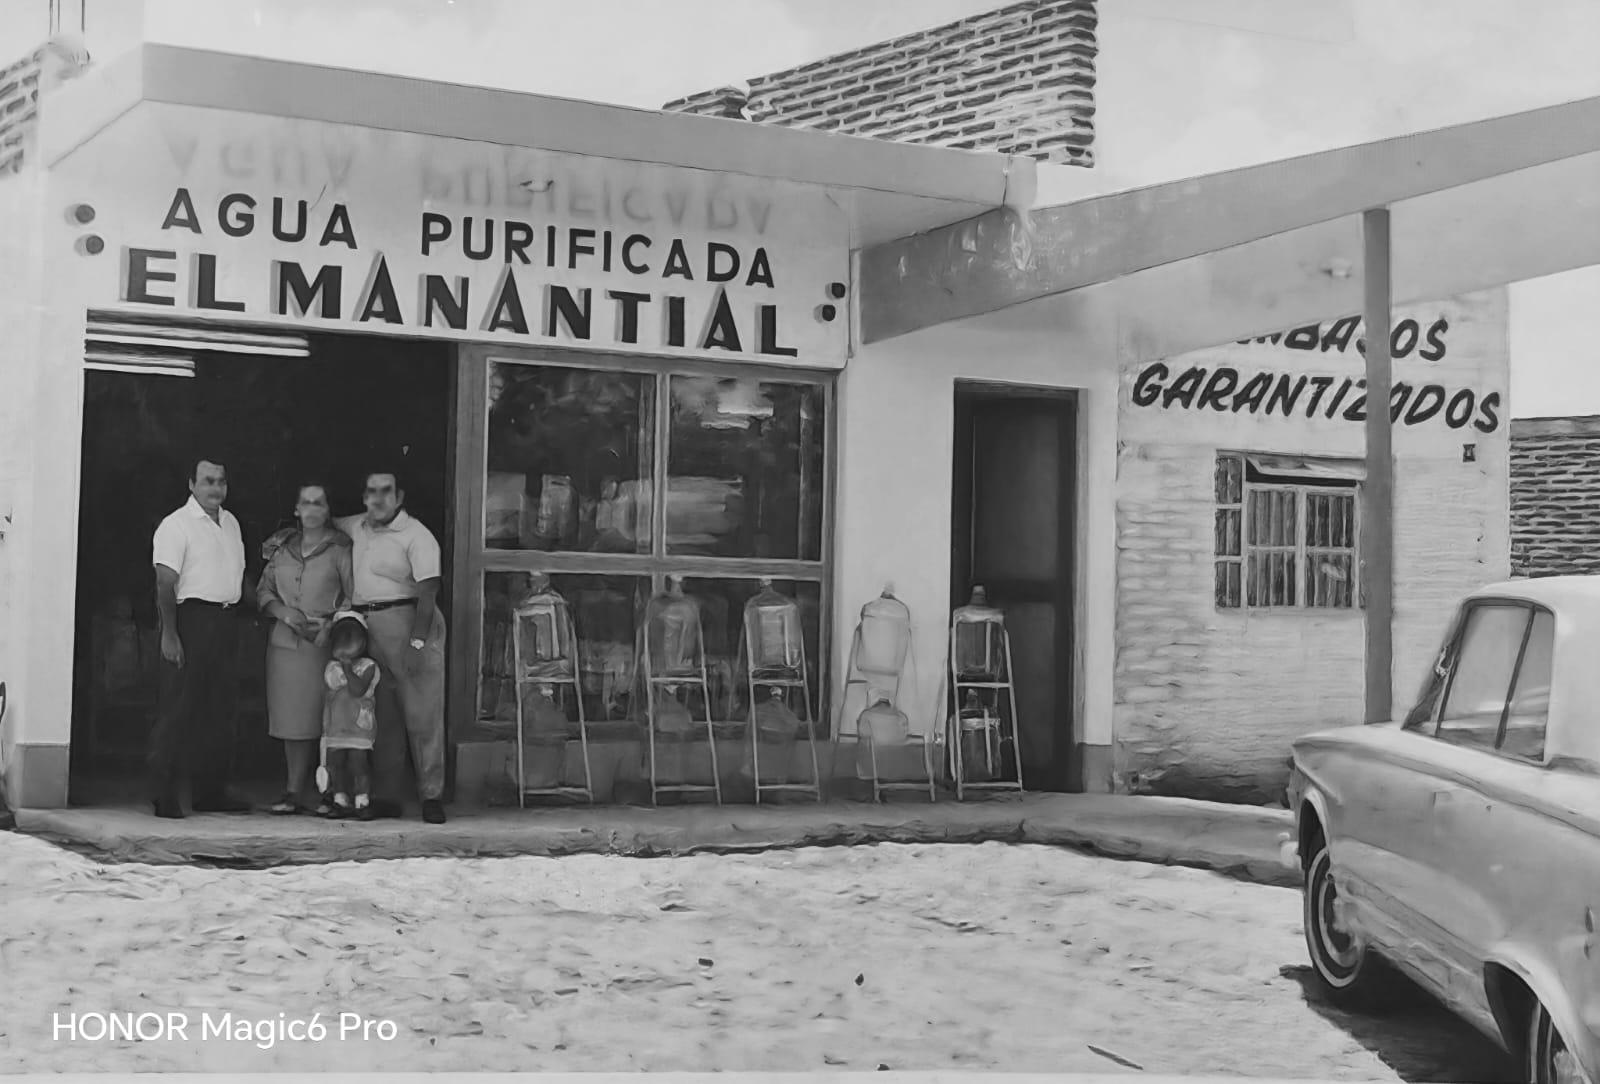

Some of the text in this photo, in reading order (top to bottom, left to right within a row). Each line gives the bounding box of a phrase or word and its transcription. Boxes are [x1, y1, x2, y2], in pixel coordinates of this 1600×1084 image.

[161, 187, 775, 289] AGUA PURIFICADA
[121, 245, 798, 357] EL MANANTIAL
